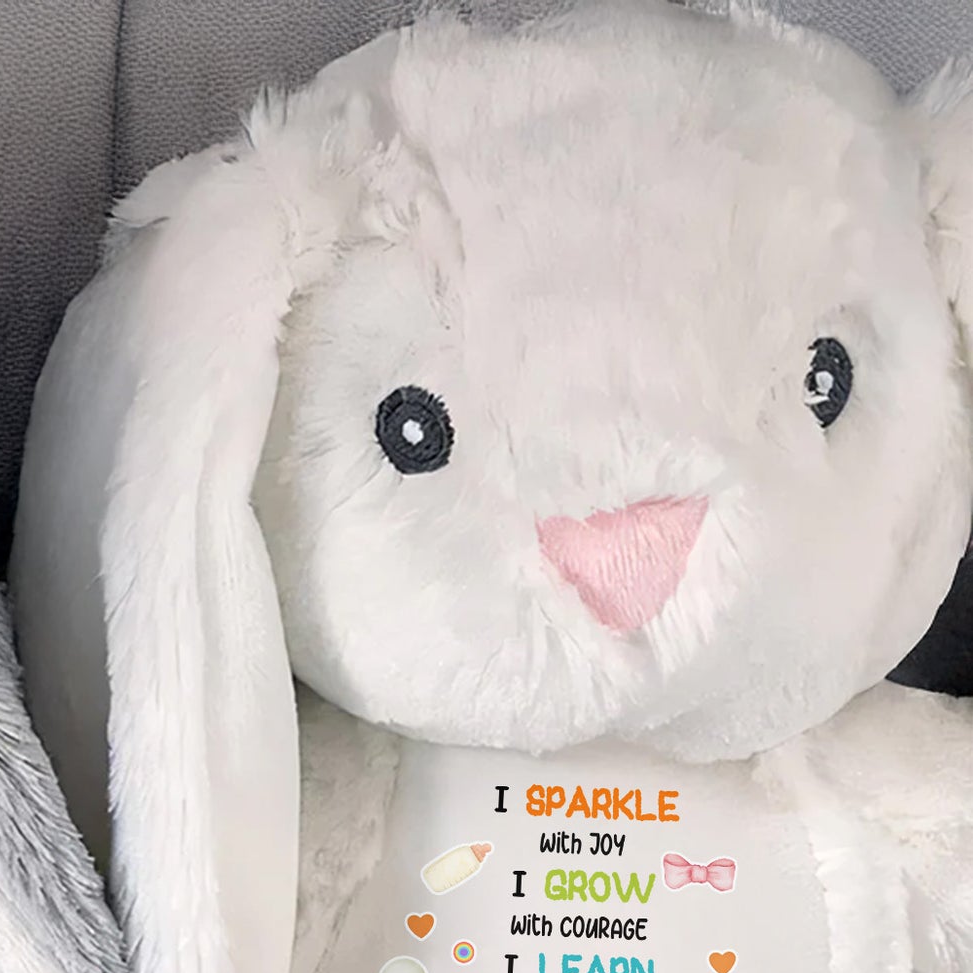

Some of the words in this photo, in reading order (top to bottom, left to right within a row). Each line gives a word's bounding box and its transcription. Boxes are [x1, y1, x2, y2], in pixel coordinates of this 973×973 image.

[495, 786, 509, 813] I
[526, 784, 680, 822] SPARKLE
[590, 833, 625, 856] JOY
[513, 871, 526, 897] I
[545, 869, 655, 904] GROW
[560, 915, 648, 940] COURAGE
